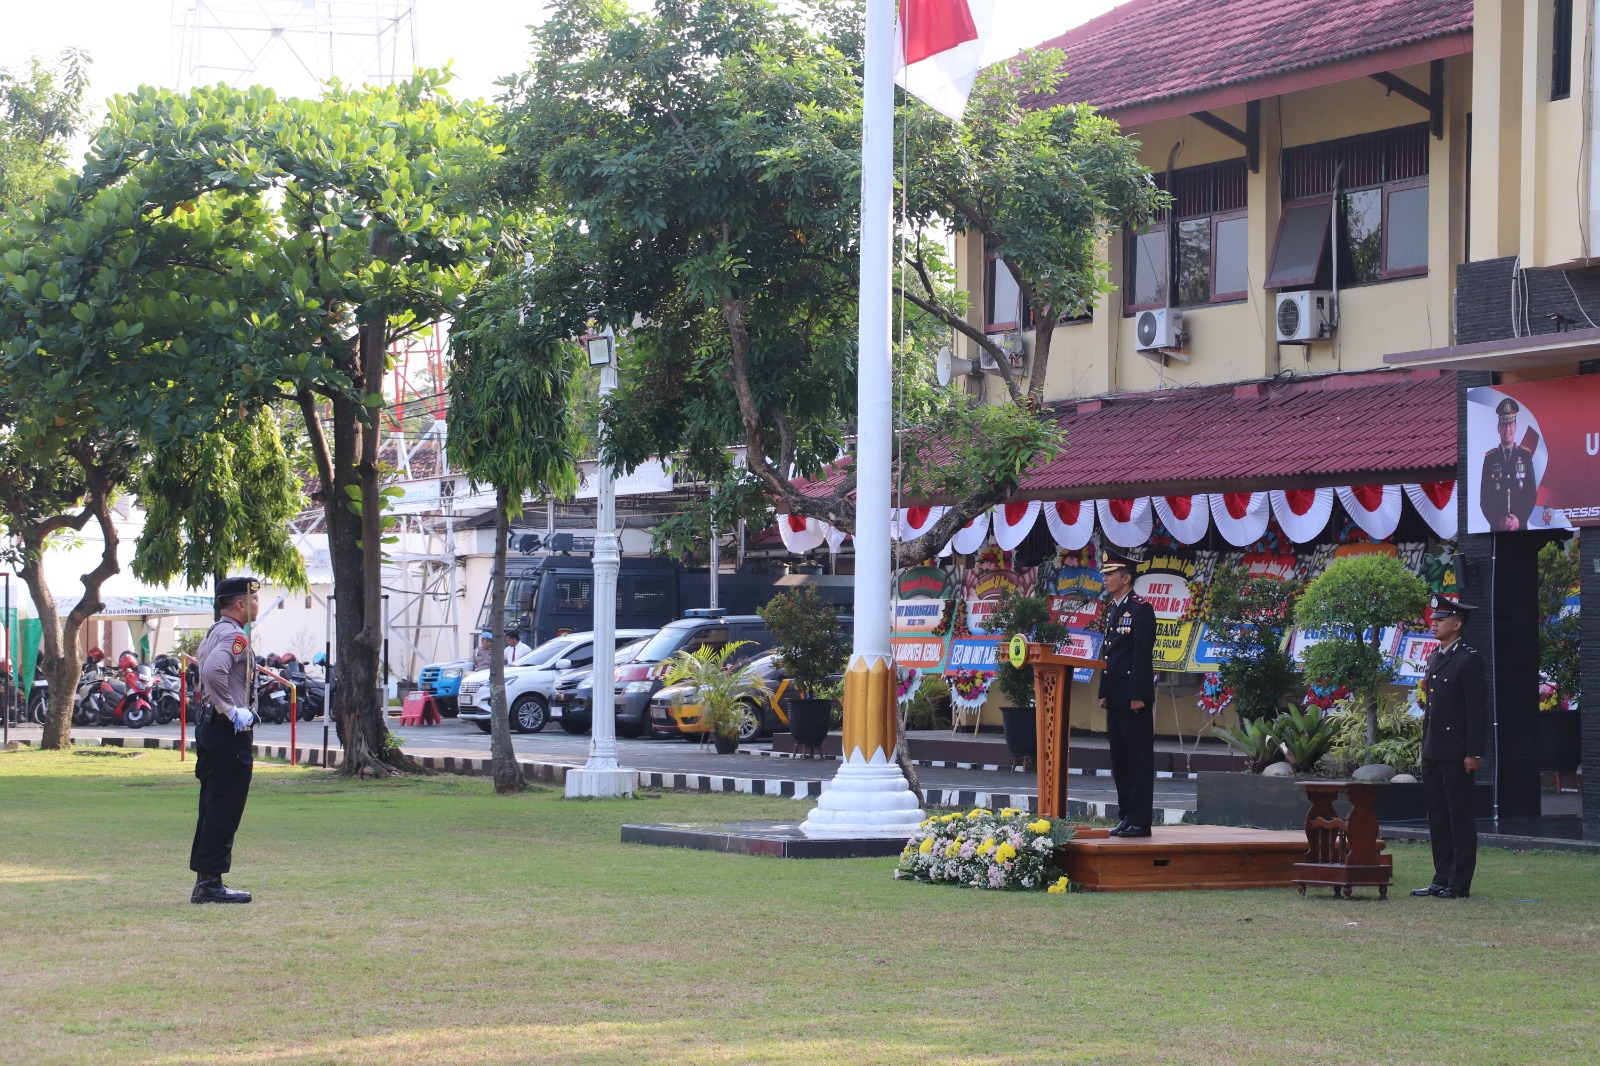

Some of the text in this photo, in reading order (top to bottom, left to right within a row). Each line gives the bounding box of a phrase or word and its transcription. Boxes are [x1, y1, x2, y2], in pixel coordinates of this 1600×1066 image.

[1554, 507, 1600, 518] PRESIS
[1148, 583, 1172, 595] HUT
[1169, 598, 1180, 613] Ke
[917, 618, 926, 626] 78
[1069, 615, 1078, 623] 78
